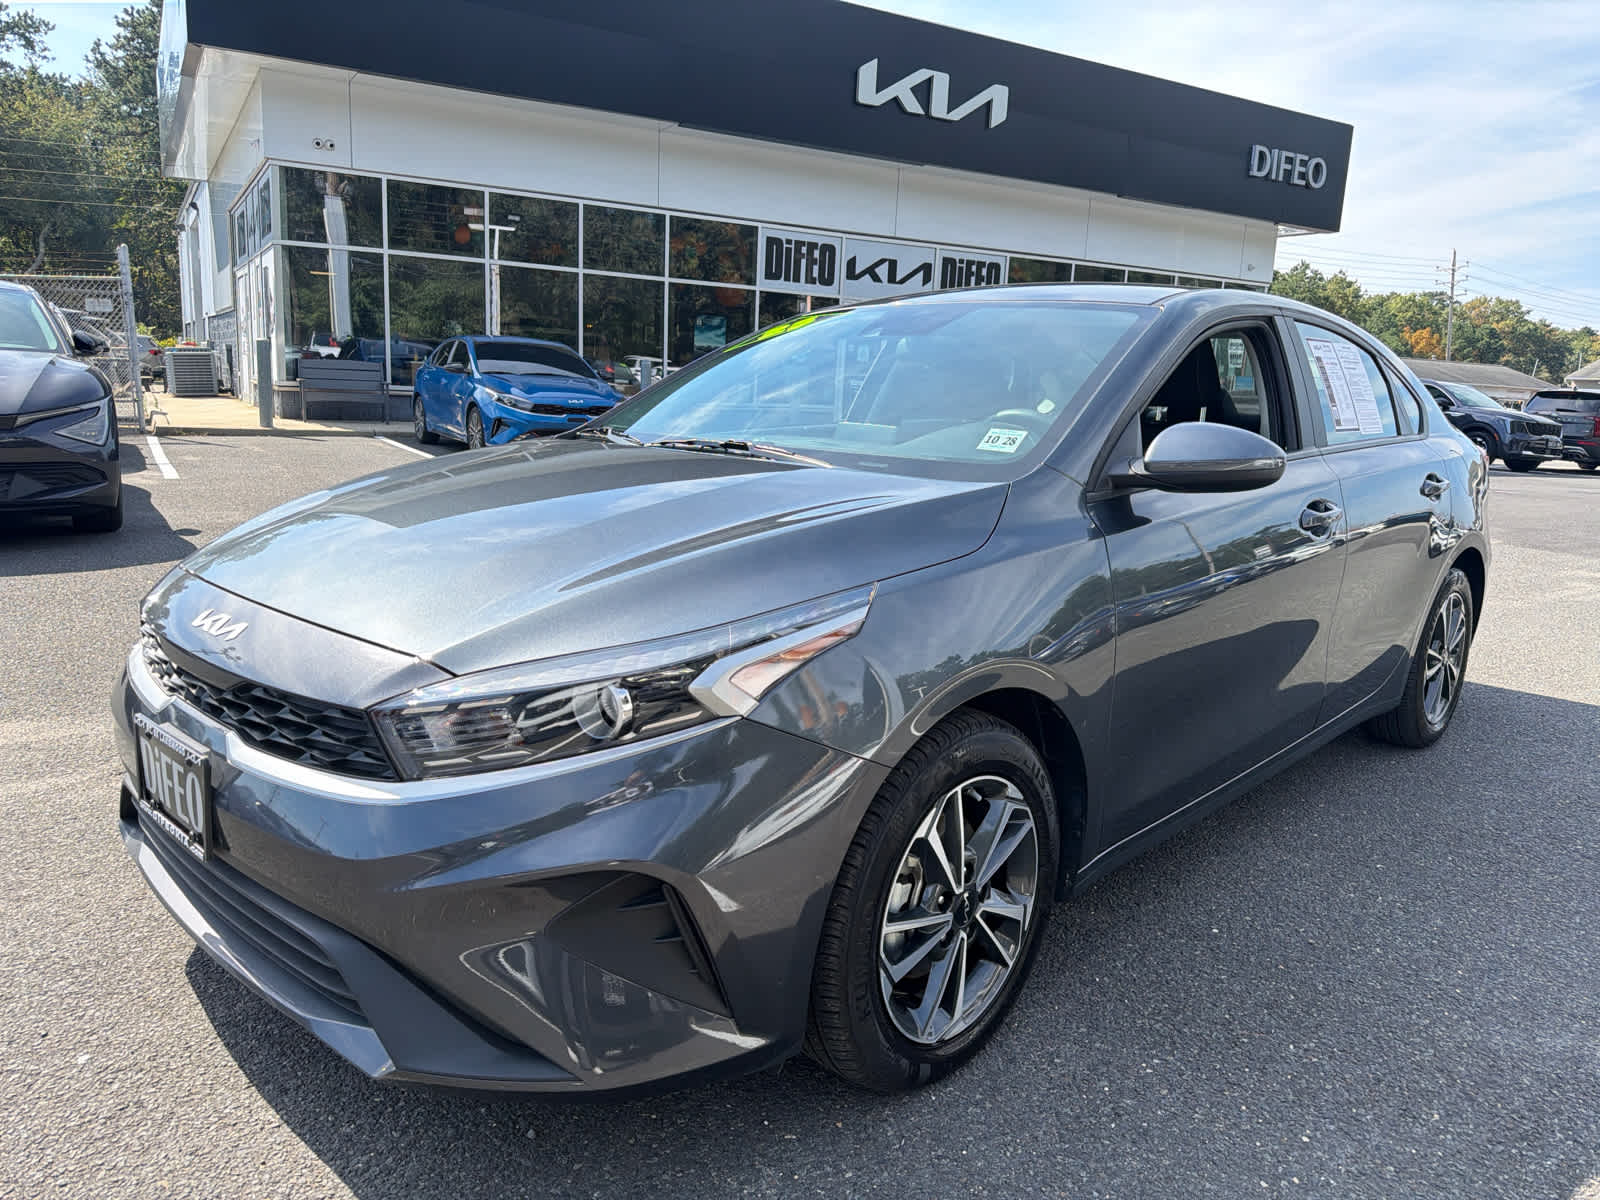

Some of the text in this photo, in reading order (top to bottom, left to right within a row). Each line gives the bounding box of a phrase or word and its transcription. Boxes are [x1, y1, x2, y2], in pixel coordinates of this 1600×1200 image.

[857, 58, 1009, 129] KIA
[1249, 144, 1327, 190] DIFEO
[846, 255, 933, 287] KIA
[984, 435, 1018, 446] 10 28
[192, 608, 248, 641] KIA
